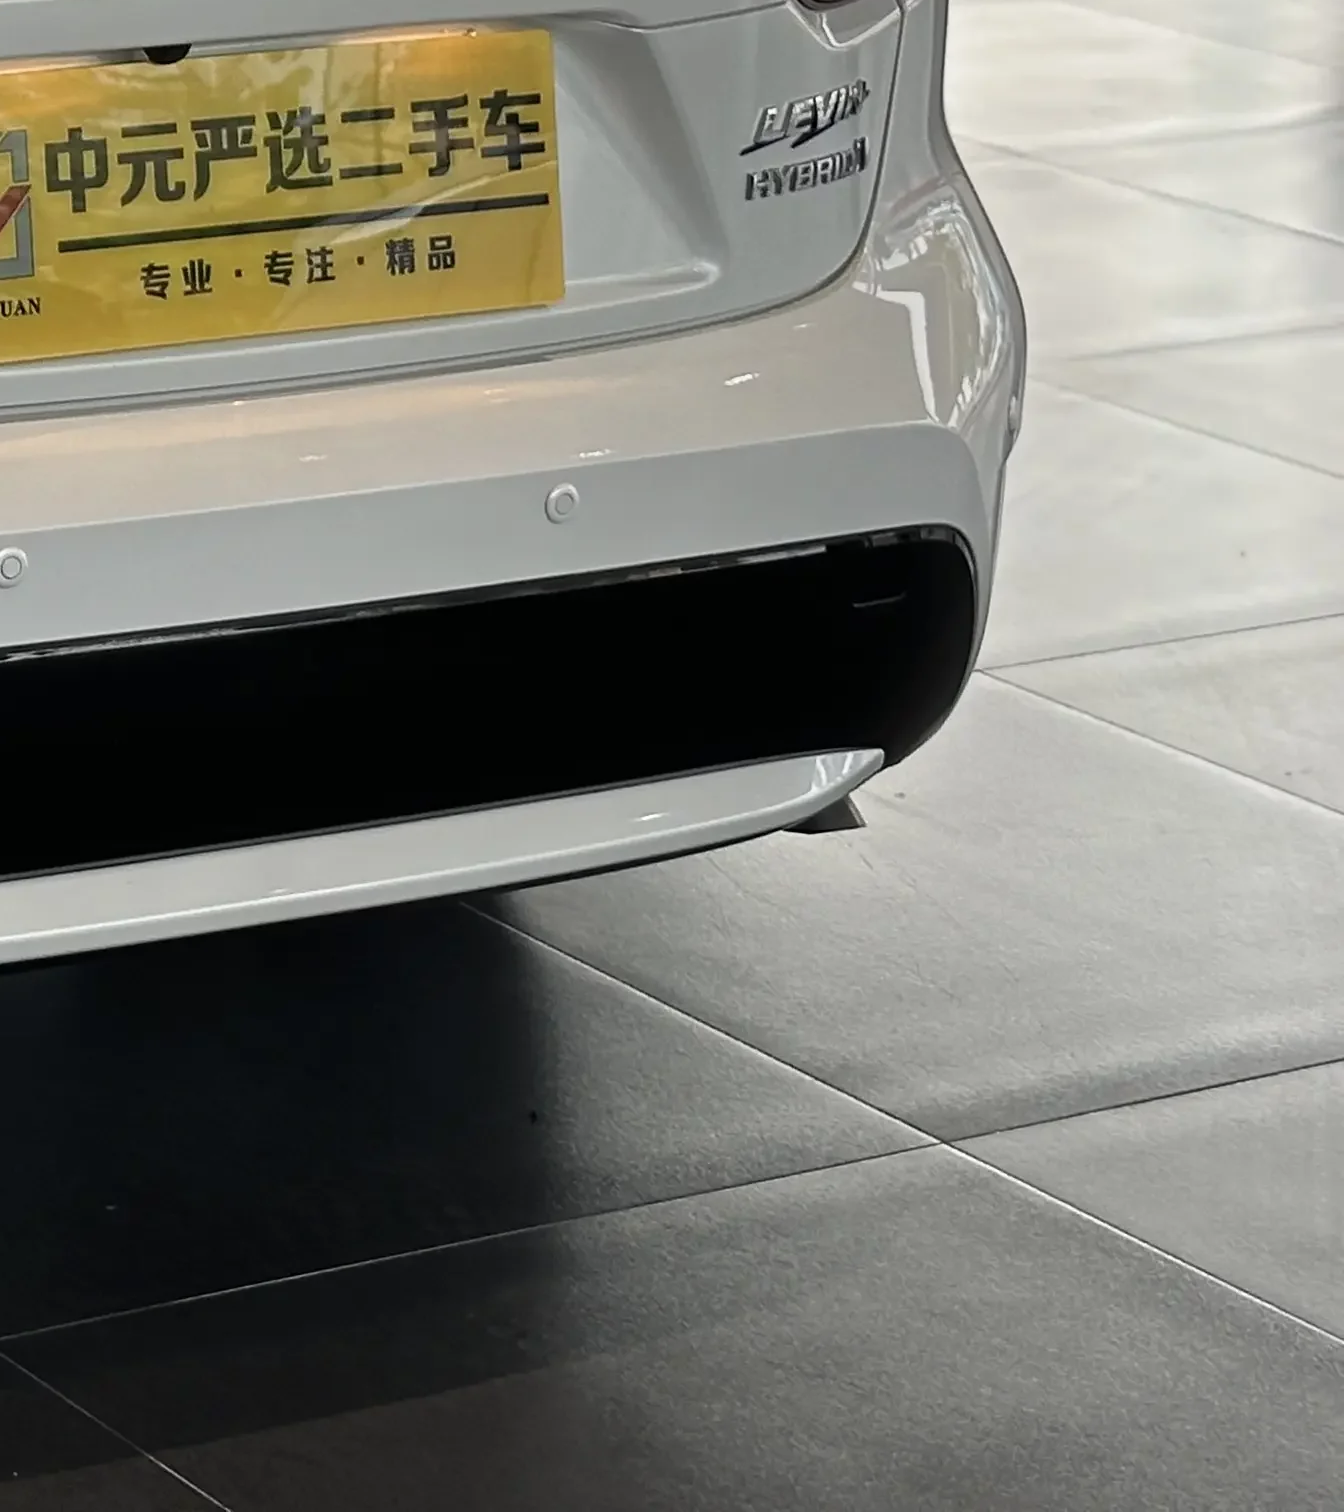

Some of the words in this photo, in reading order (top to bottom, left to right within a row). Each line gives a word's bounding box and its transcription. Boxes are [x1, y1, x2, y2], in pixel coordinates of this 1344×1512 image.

[740, 79, 870, 150] LEVIN
[44, 89, 546, 214] 中元严选二手车
[745, 136, 869, 201] HYBRID
